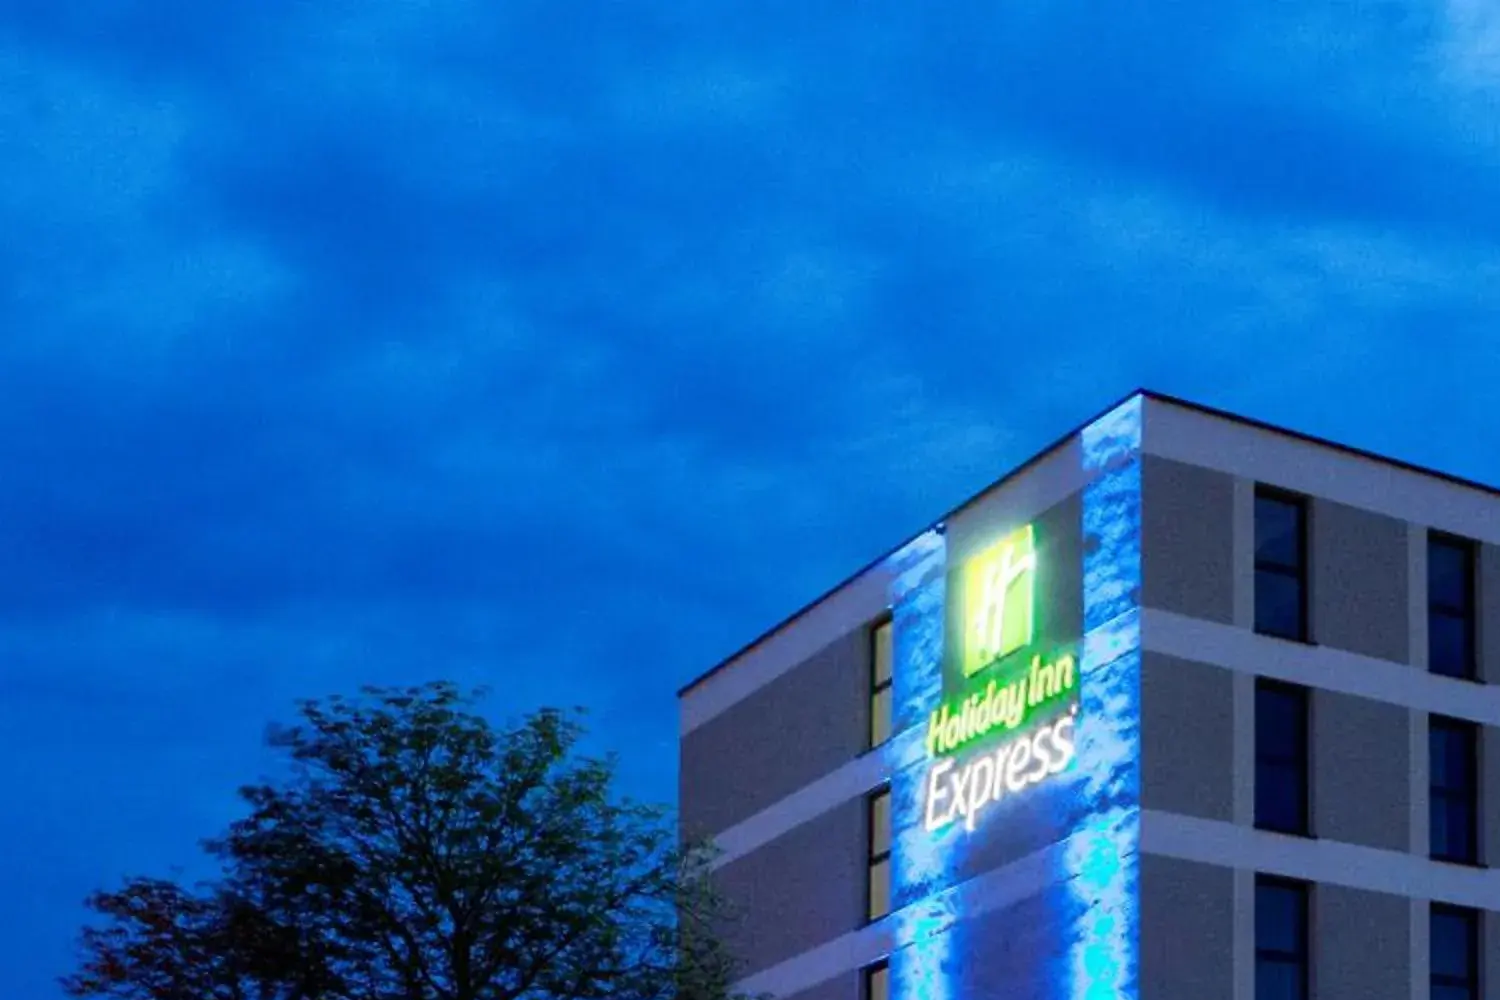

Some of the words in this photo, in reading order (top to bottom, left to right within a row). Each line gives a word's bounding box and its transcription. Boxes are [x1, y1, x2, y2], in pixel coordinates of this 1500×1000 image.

[927, 677, 1027, 758] Holiday
[1028, 655, 1074, 706] Inn
[924, 713, 1077, 833] Express
